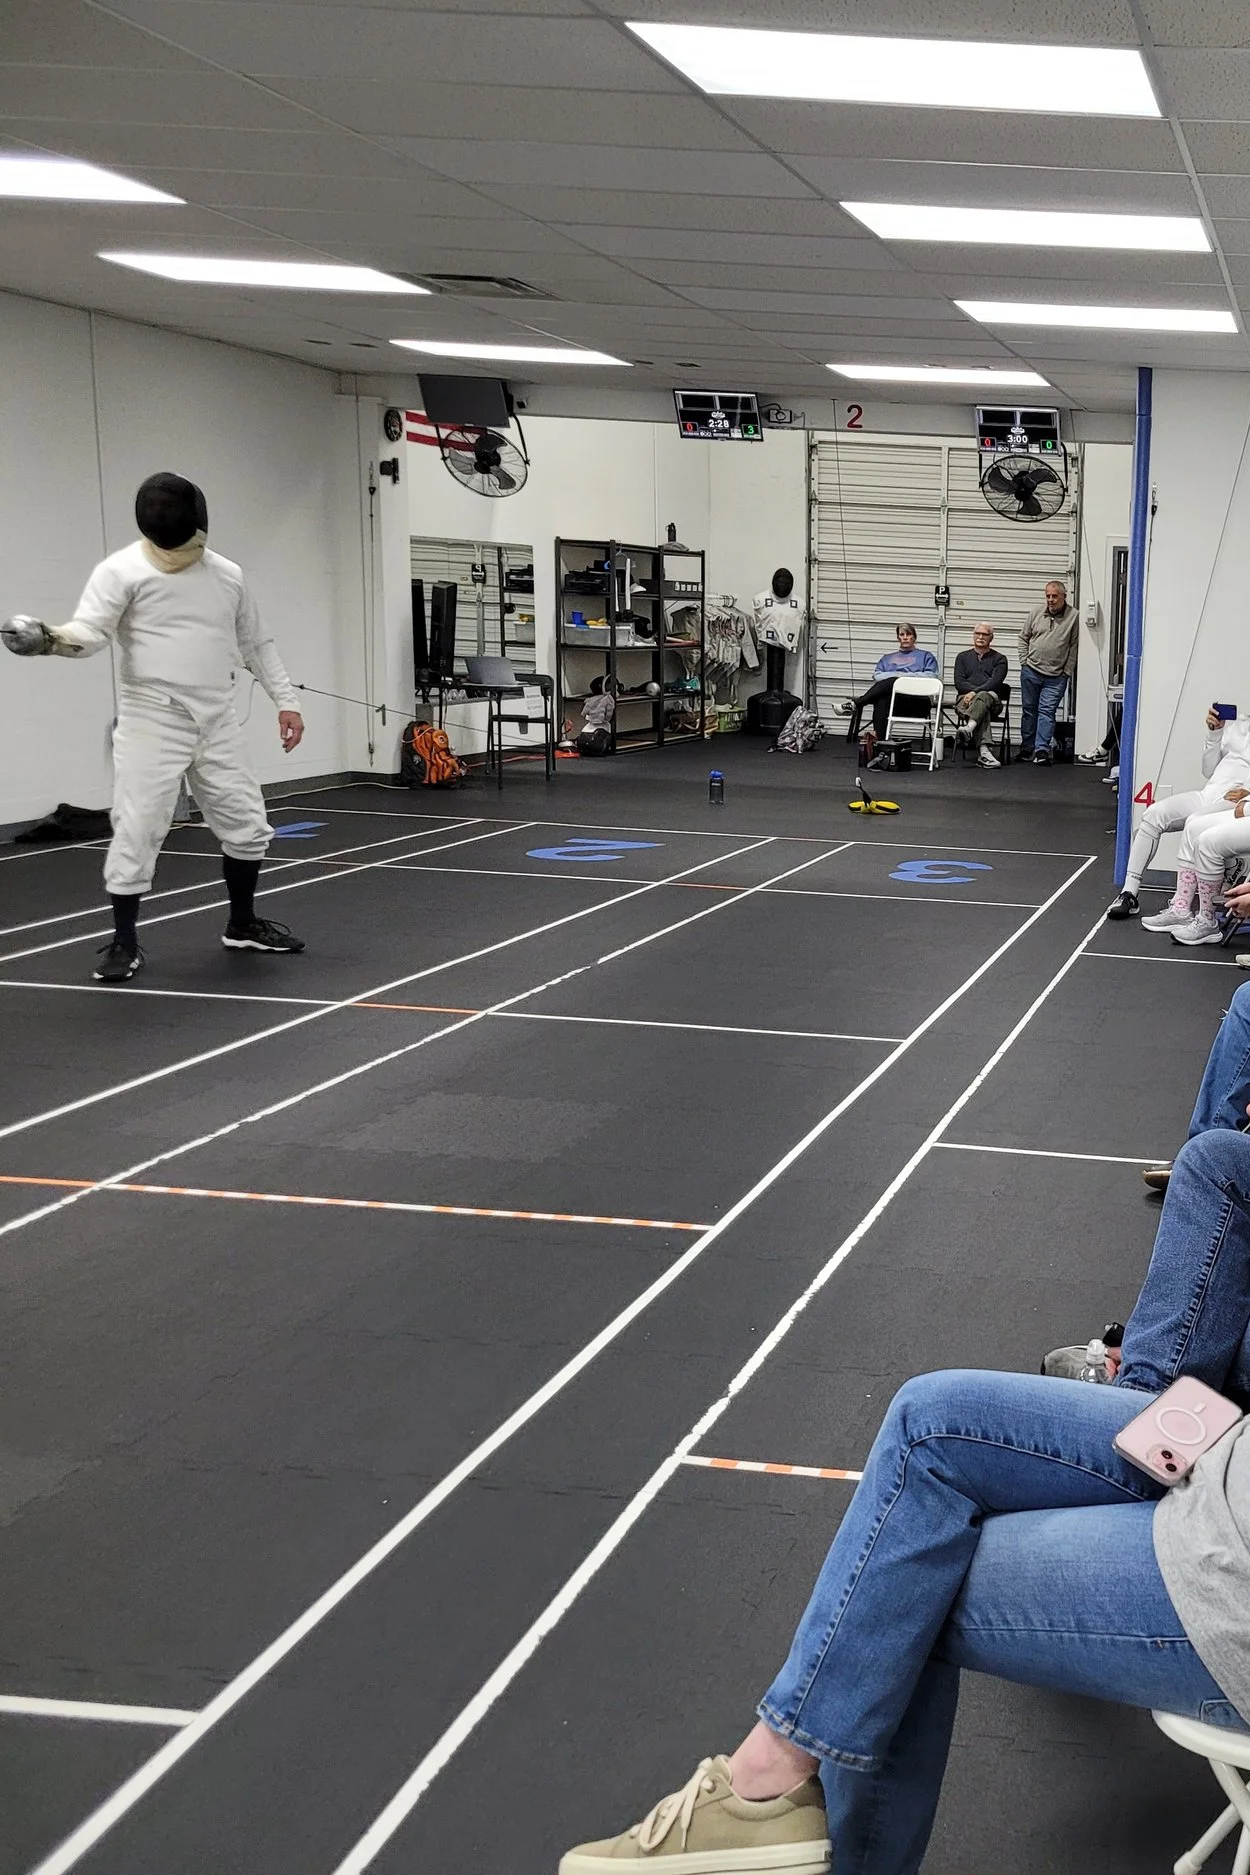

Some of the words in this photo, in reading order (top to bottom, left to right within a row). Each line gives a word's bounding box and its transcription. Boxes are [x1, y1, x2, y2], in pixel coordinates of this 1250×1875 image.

[847, 404, 863, 428] 2
[686, 423, 693, 432] 0
[708, 419, 729, 428] 2:28
[747, 425, 754, 434] 3
[984, 438, 991, 447] 0
[1007, 434, 1028, 443] 3:00
[1046, 441, 1053, 449] 0
[939, 586, 946, 594] P
[1133, 781, 1156, 809] 4
[525, 837, 666, 862] 2
[888, 860, 993, 884] 3
